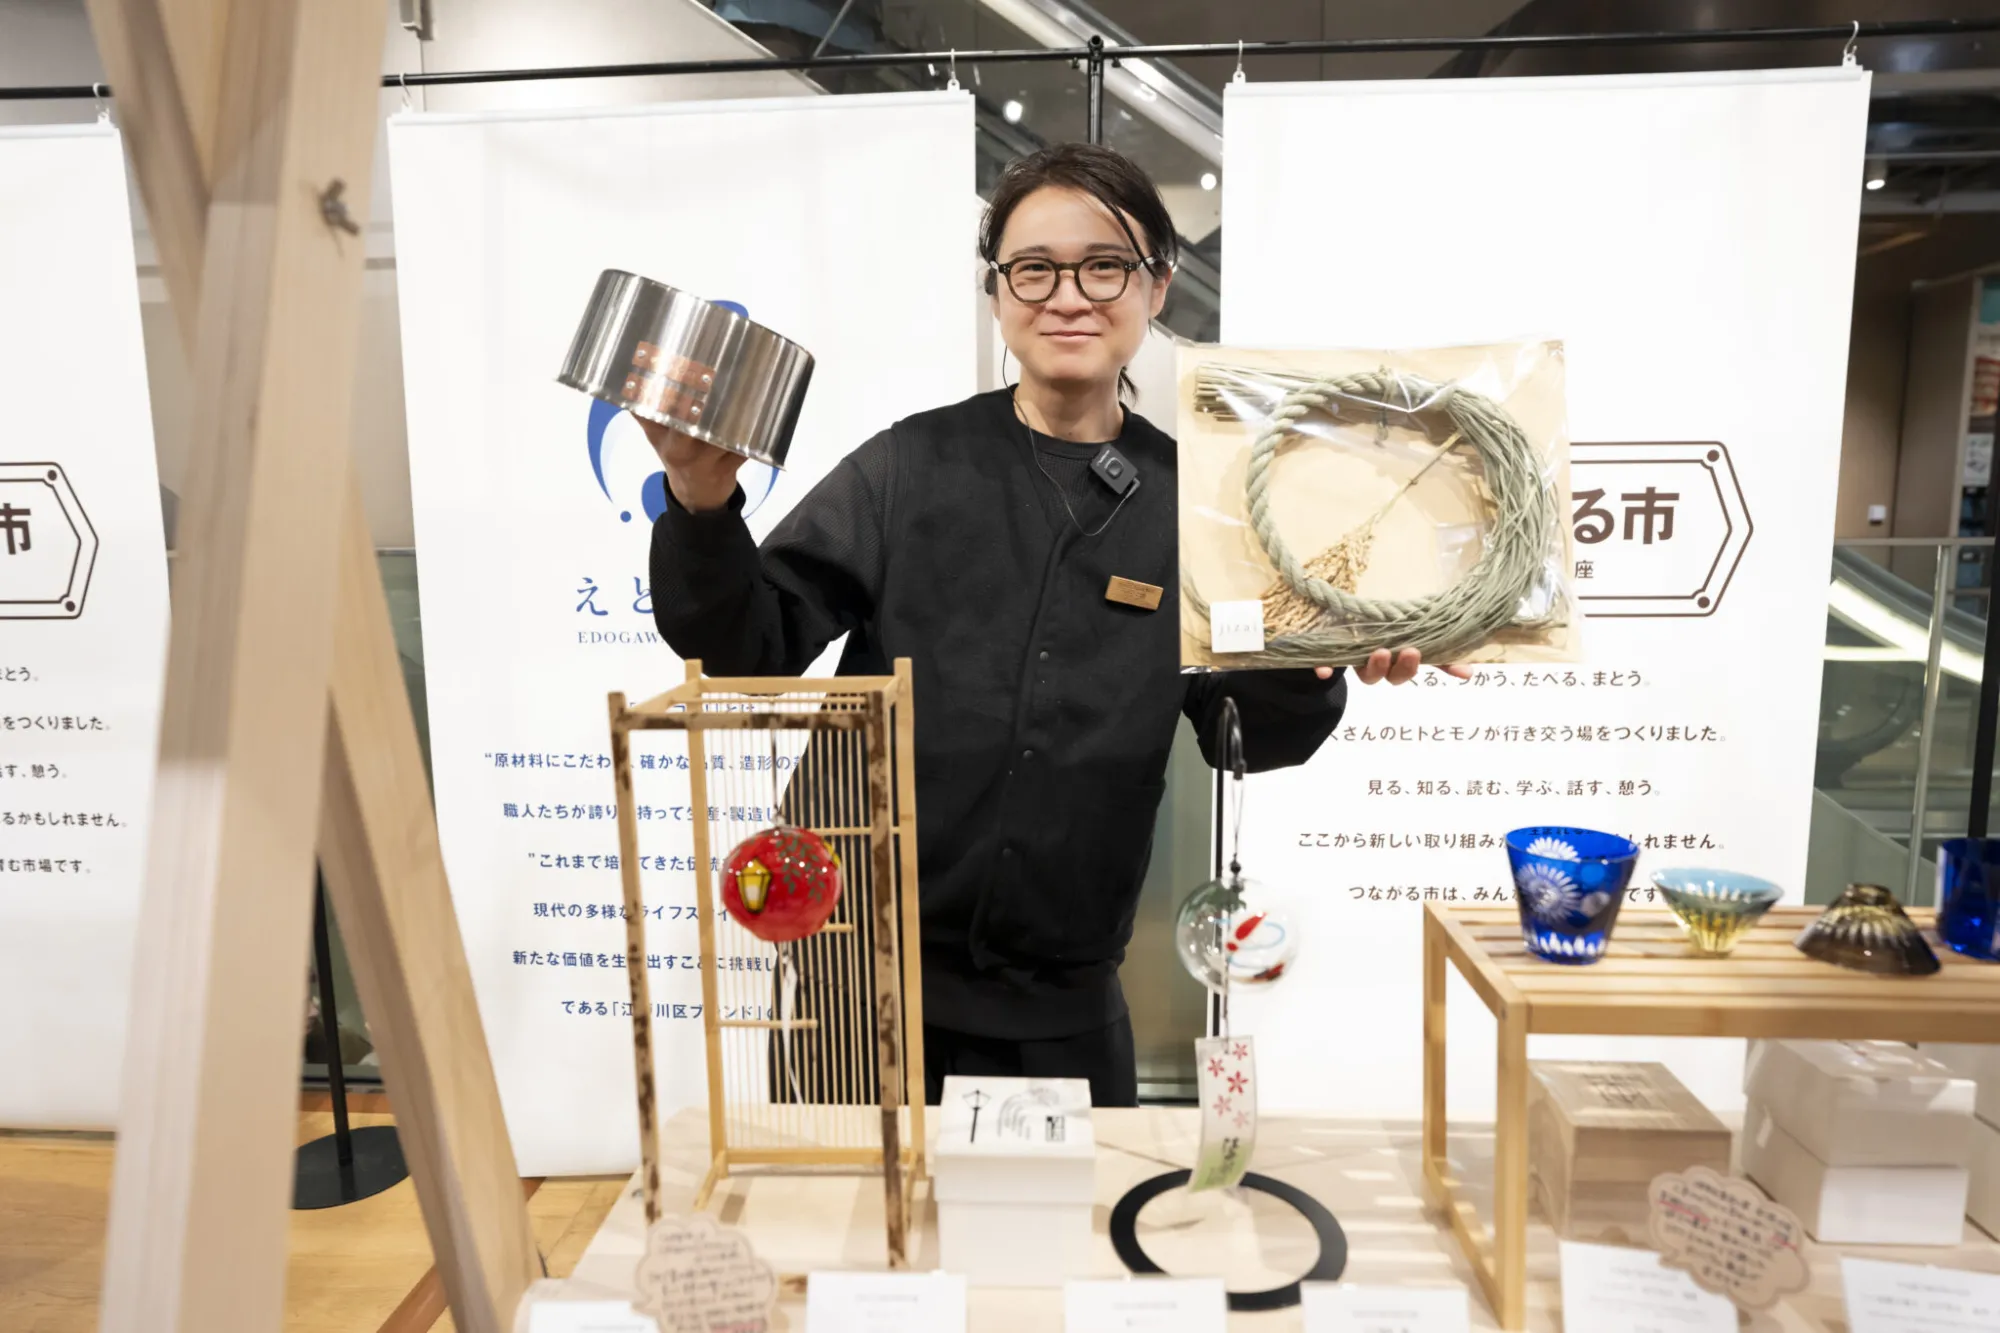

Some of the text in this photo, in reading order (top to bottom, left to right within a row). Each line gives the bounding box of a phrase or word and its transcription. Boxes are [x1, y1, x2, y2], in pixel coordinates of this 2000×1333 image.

[1574, 560, 1594, 579] 座
[577, 630, 666, 644] EDOGAW
[0, 667, 39, 682] とう。
[0, 764, 67, 779] す、憩う。
[1367, 779, 1660, 797] 見る、知る、読む、学ぶ、話す、憩う。
[0, 859, 91, 874] む市場です。
